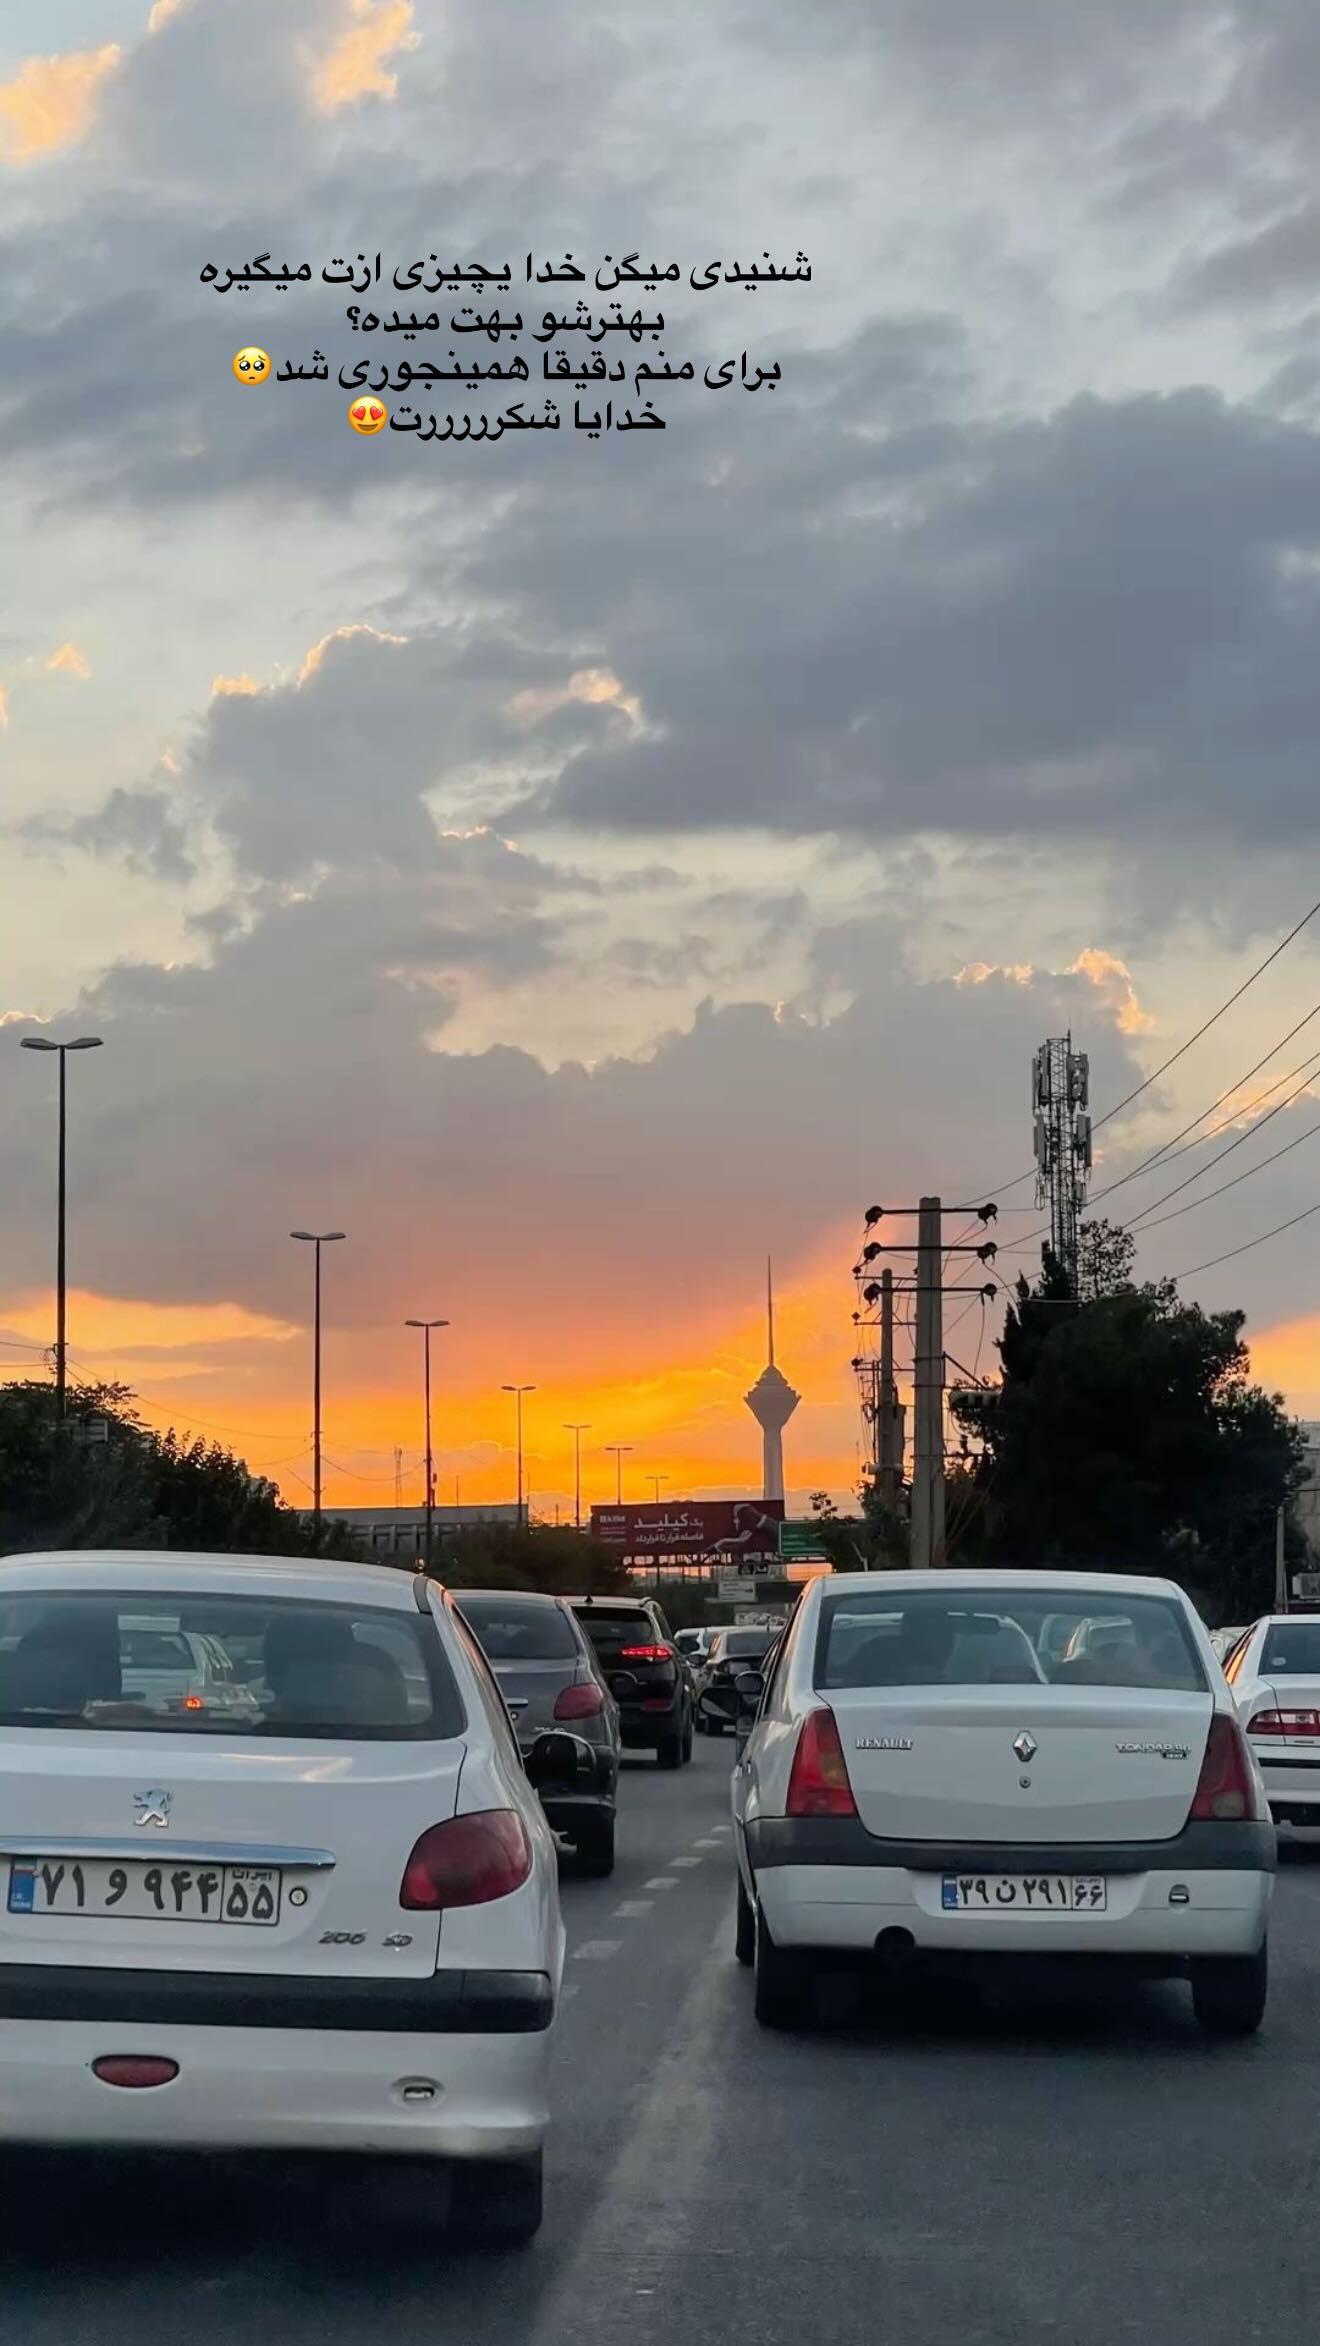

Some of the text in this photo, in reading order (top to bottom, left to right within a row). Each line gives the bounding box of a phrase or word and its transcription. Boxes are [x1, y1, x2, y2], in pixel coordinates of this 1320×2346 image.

[856, 1737, 912, 1750] RENAULT
[42, 1863, 219, 1914] ۷۱ و ۹۴۴
[226, 1882, 274, 1919] ۵۵
[995, 1879, 1017, 1903] ن
[1074, 1884, 1103, 1907] ۶۶
[318, 1931, 367, 1945] 206
